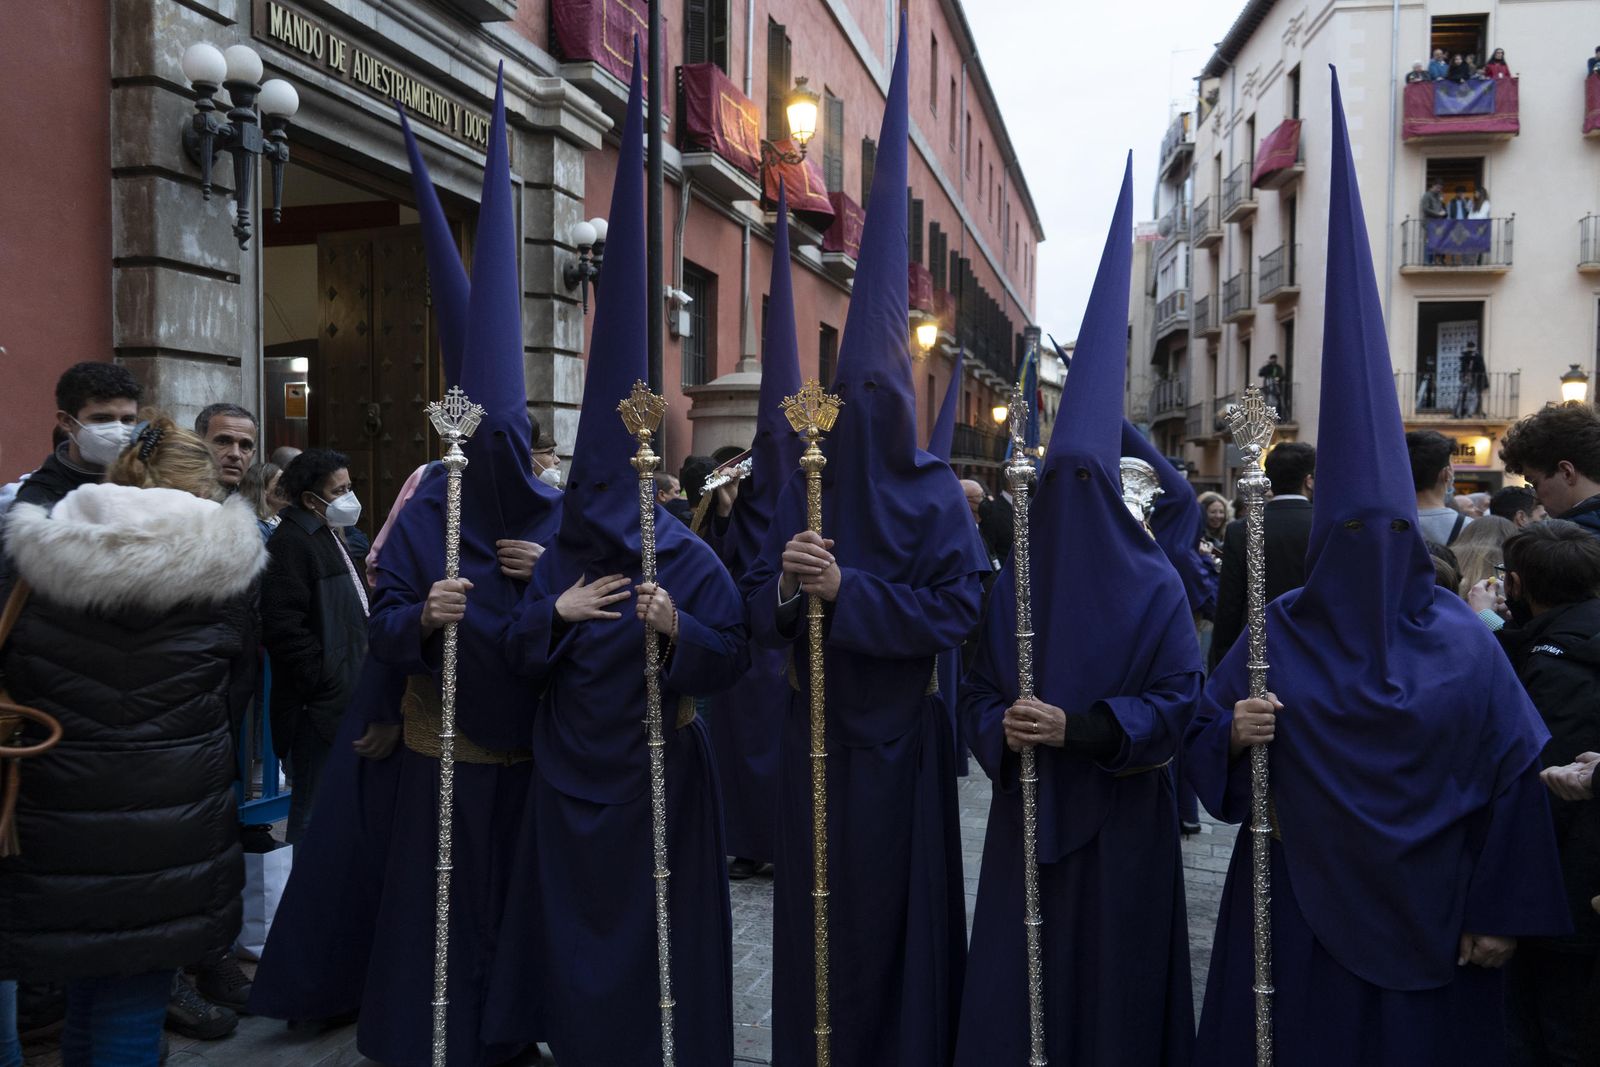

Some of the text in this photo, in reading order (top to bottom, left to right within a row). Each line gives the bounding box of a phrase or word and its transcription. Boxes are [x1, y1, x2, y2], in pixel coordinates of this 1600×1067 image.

[270, 2, 490, 147] MANDO DE ADIESTRAMIENTO Y DOCT
